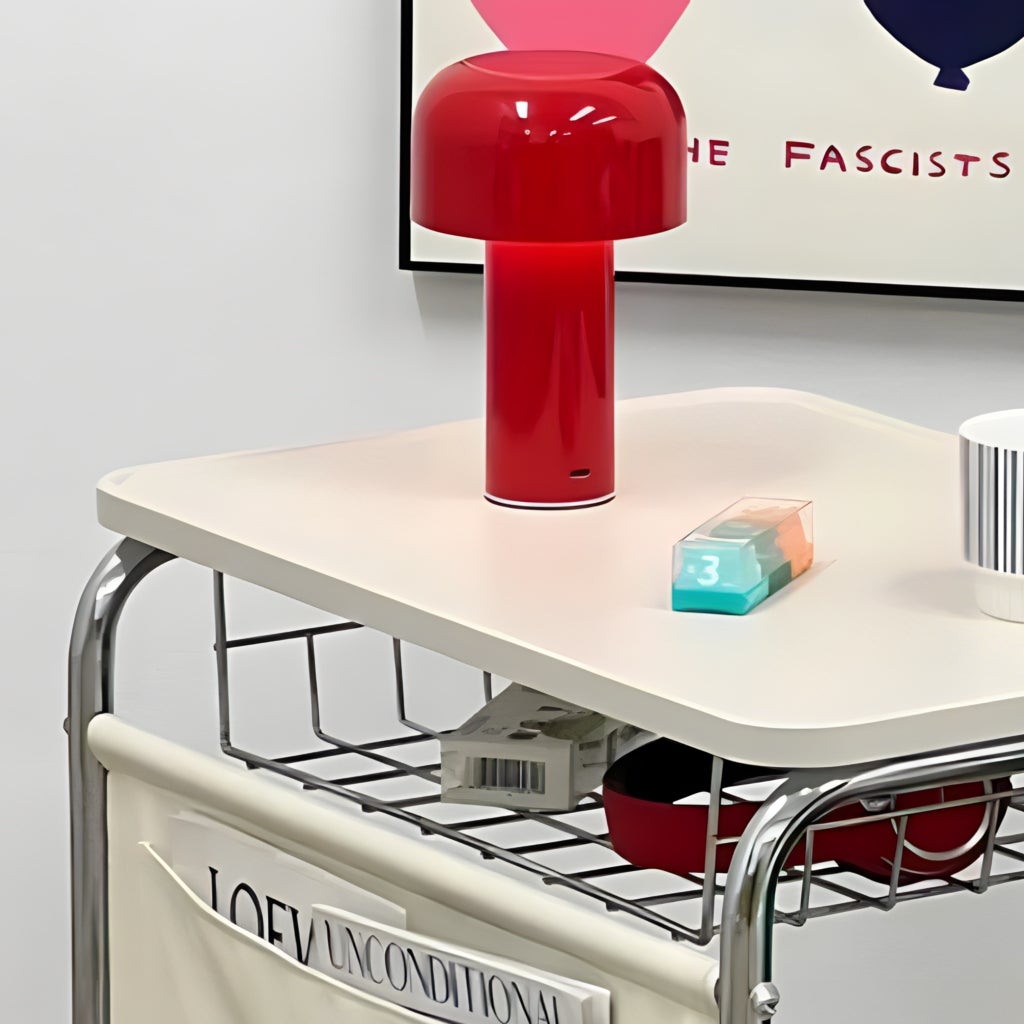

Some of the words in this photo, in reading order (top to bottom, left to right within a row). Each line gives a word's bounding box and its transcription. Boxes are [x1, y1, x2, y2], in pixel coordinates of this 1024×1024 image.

[687, 137, 730, 167] HE
[784, 140, 1011, 178] FASCISTS
[697, 555, 720, 586] 3
